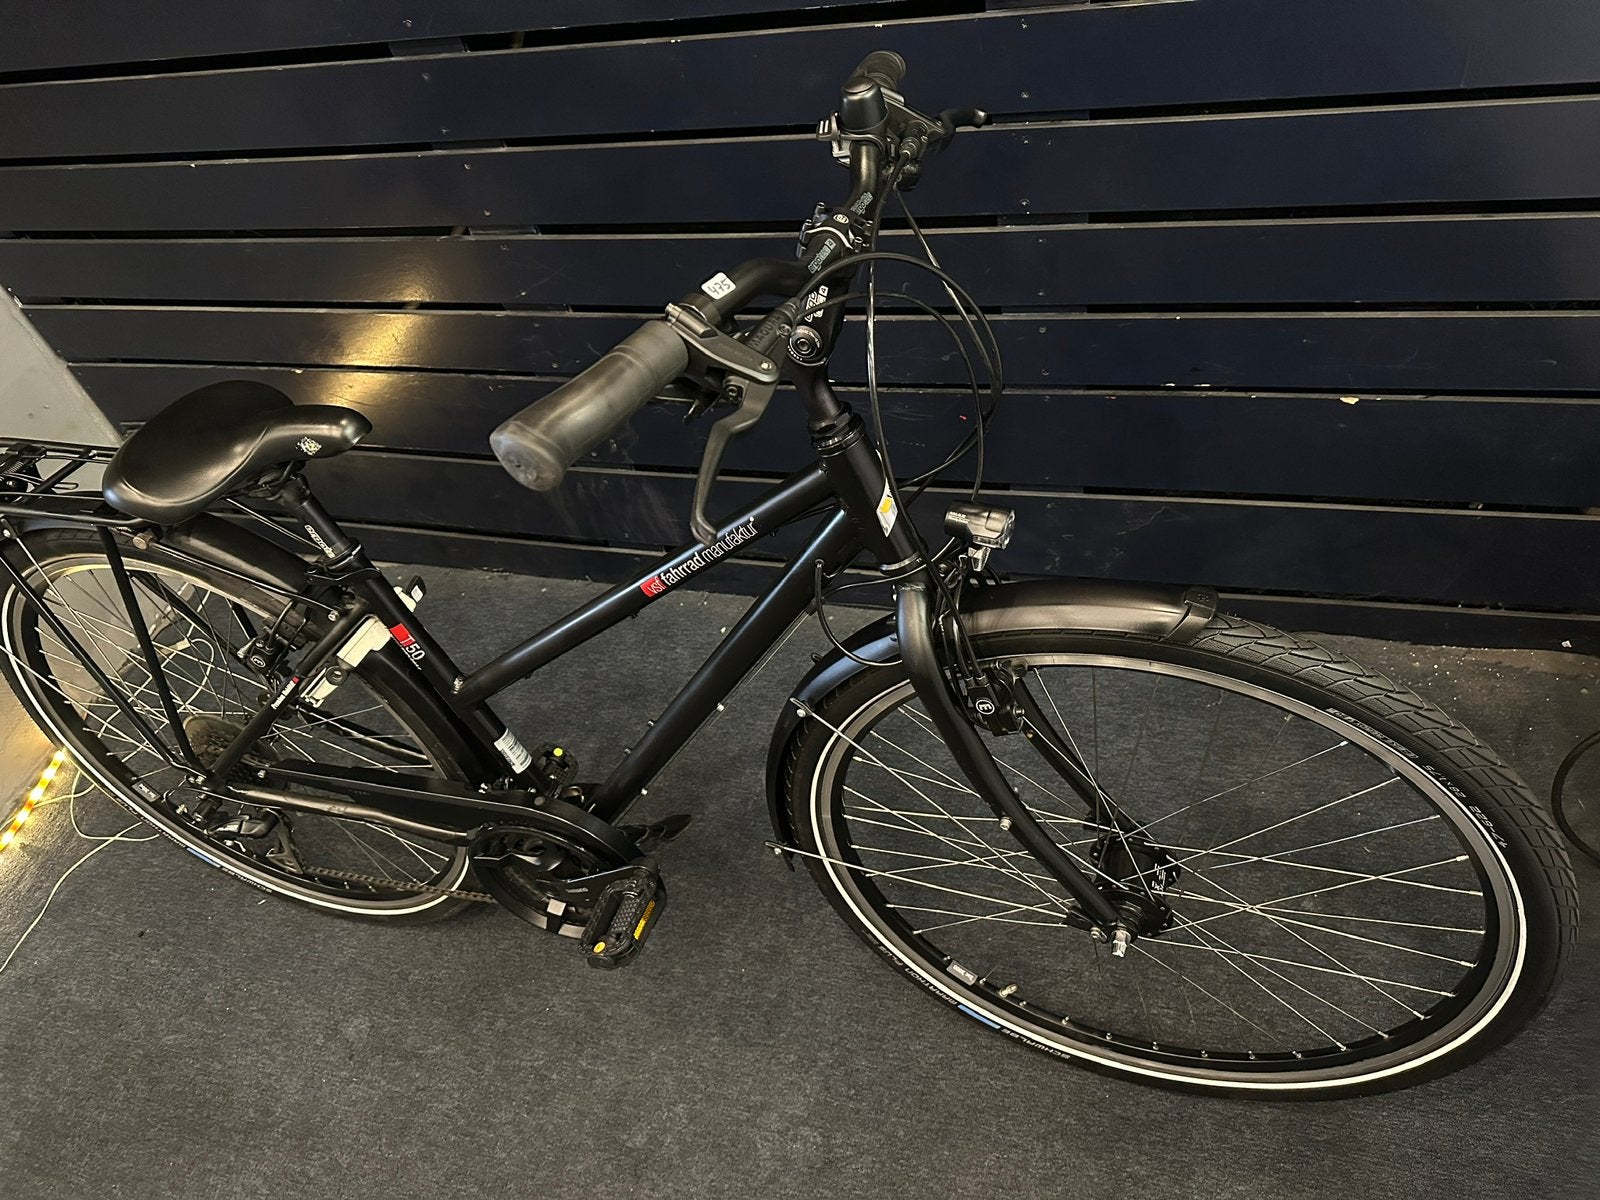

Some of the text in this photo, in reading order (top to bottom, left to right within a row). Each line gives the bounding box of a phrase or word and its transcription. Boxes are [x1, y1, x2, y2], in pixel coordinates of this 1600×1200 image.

[808, 246, 831, 273] ergotec
[708, 278, 731, 294] 475
[748, 315, 785, 348] MAGURA
[648, 521, 758, 594] vsf fahrrad manufaktur
[1468, 805, 1508, 848] 47-622
[878, 944, 1070, 1060] SCHWALBE MARATHON PLUS
